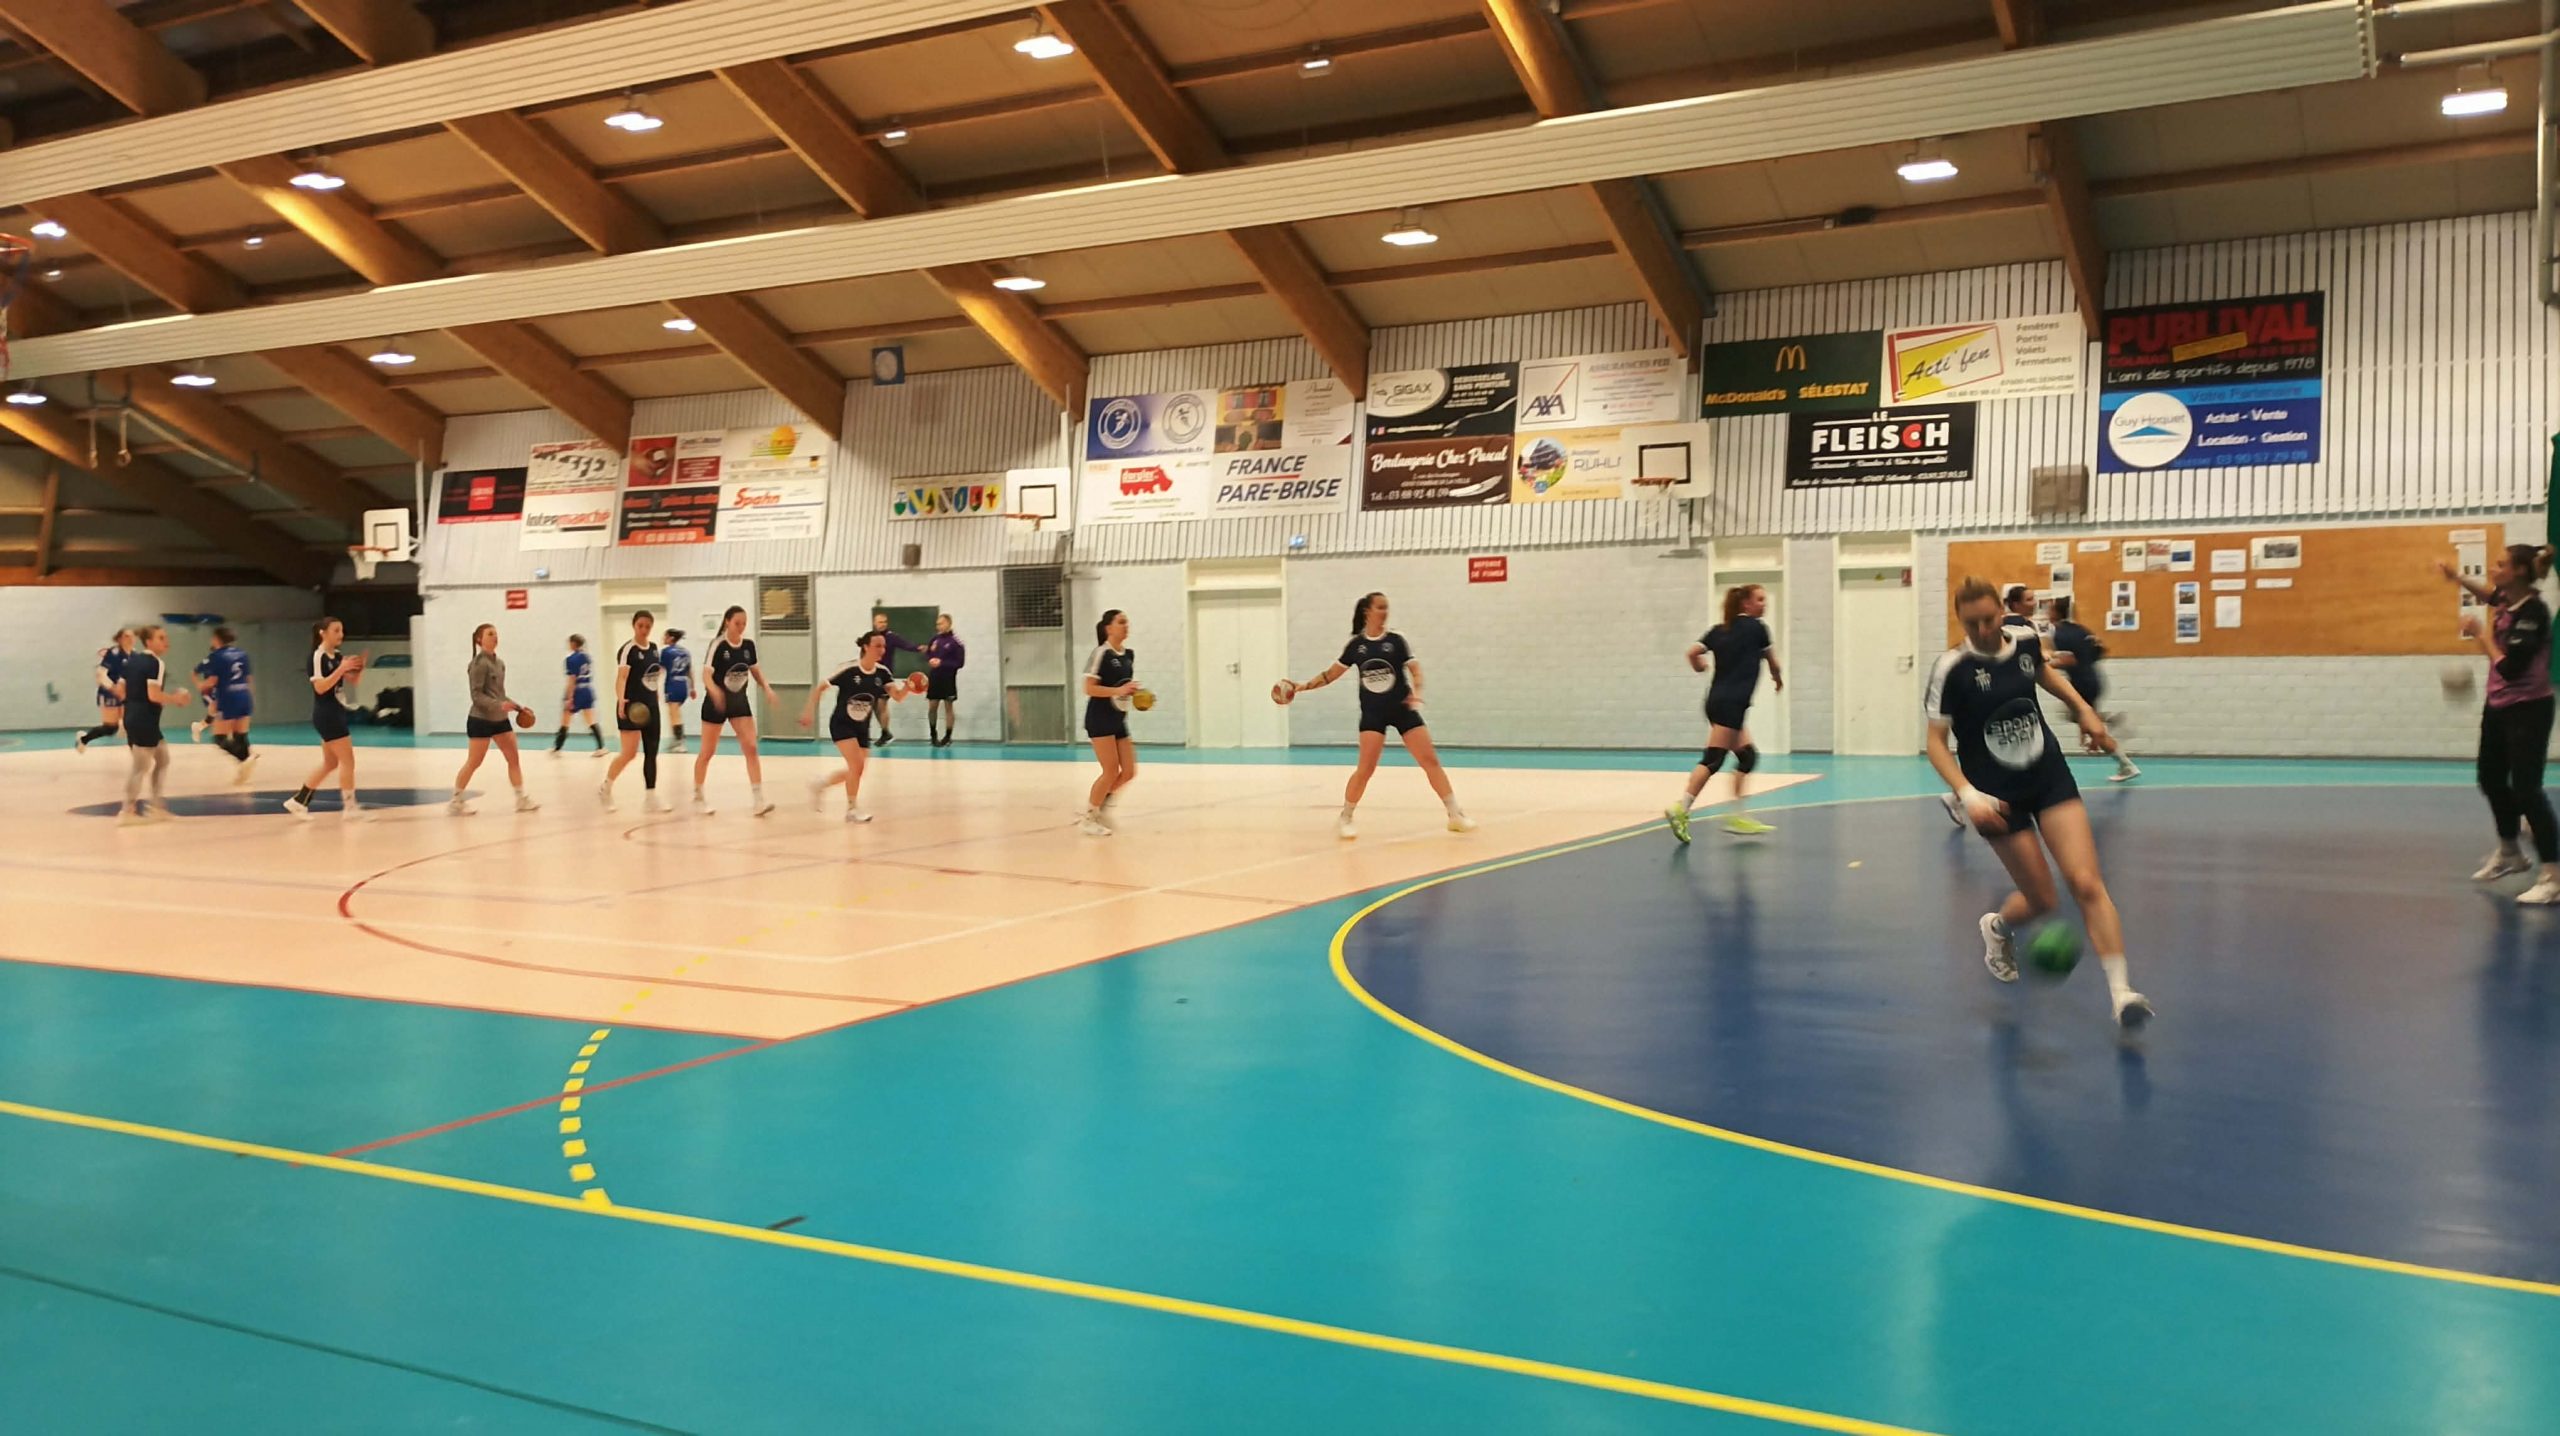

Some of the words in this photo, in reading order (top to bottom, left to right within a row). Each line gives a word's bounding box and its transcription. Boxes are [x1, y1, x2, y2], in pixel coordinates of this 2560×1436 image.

[2016, 321, 2060, 331] Fenêtres
[2016, 333, 2048, 343] Portes
[2015, 345, 2046, 355] Volets
[2014, 355, 2073, 367] Fermetures
[2107, 369, 2142, 384] L'ami
[2146, 367, 2171, 381] des
[2175, 364, 2232, 384] sportifs
[2236, 360, 2280, 378] depuis
[1705, 388, 1787, 405] McDonald's
[1798, 382, 1869, 399] SÉLESTAT
[1521, 394, 1566, 418] AXA
[1872, 410, 1889, 422] LE
[2114, 416, 2137, 428] Guy
[2141, 413, 2186, 428] Hoquet
[2204, 411, 2240, 424] Achat
[2251, 408, 2289, 421] Vente
[1811, 422, 1950, 454] FLEISCH
[2198, 433, 2249, 447] Location
[2260, 430, 2308, 444] Gestion
[1226, 454, 1308, 476] FRANCE
[1436, 447, 1466, 469] Chez
[1468, 445, 1508, 466] Pascal
[733, 487, 781, 510] Spahn
[1216, 478, 1342, 504] PARE-BRISE
